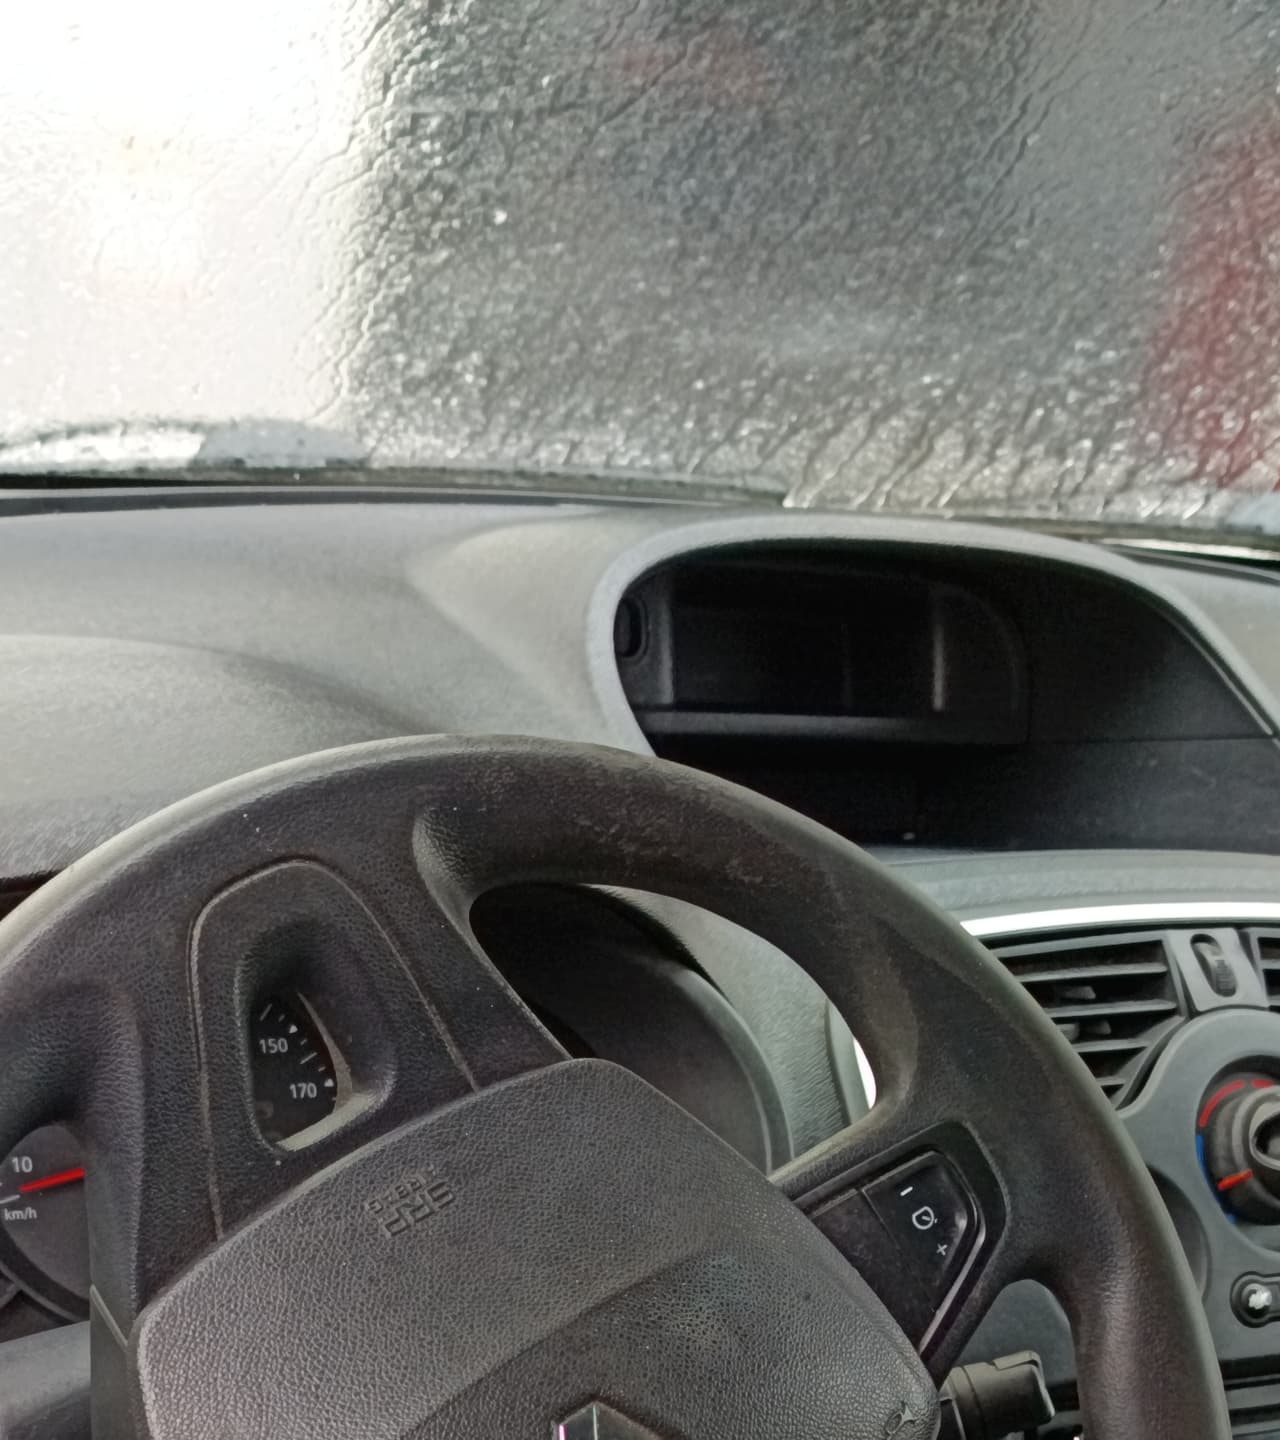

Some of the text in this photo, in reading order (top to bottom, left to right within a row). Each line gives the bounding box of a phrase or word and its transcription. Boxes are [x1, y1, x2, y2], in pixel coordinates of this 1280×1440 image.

[259, 1037, 288, 1054] 150
[289, 1082, 317, 1099] 170
[11, 1156, 33, 1173] 10
[4, 1206, 38, 1220] km/h
